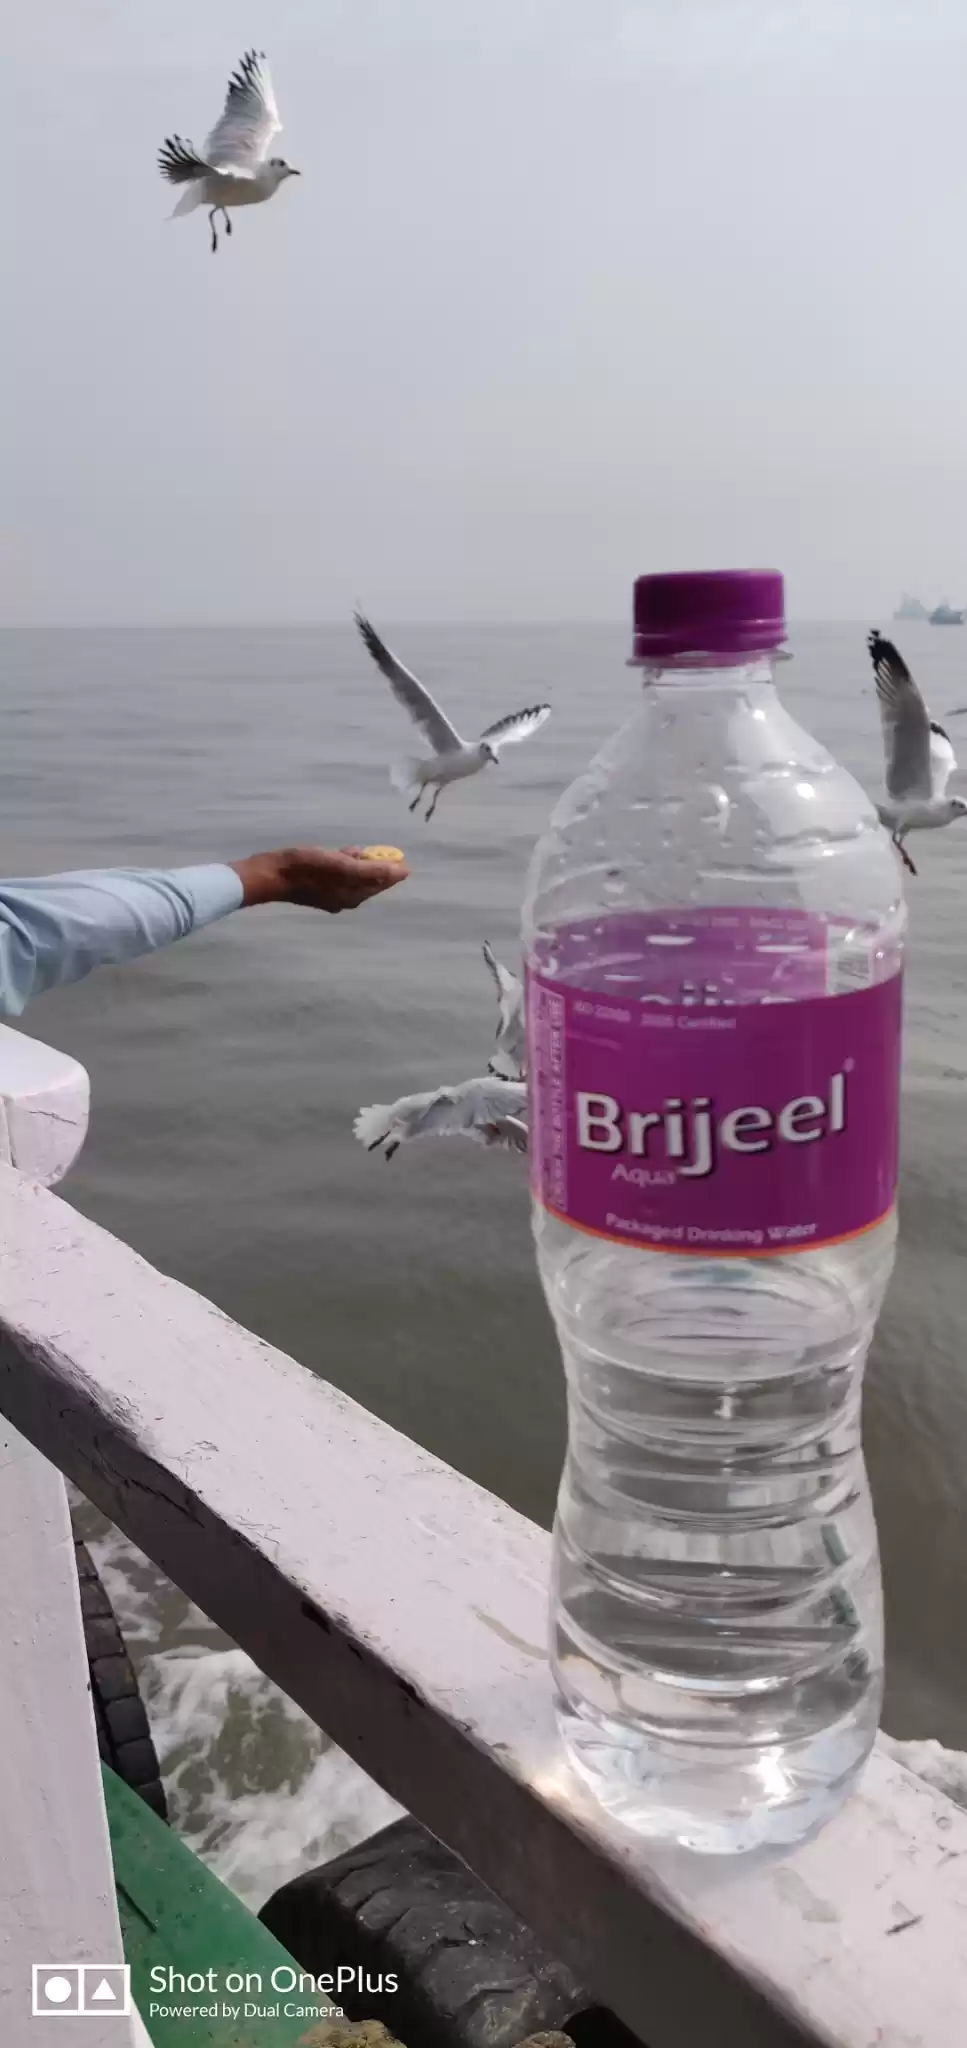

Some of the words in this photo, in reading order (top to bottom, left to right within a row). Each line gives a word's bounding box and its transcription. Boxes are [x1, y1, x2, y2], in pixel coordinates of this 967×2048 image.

[574, 1070, 848, 1177] Brijeel
[611, 1163, 677, 1187] Aqua
[605, 1212, 683, 1241] Packaged
[687, 1226, 764, 1245] Drinking
[767, 1222, 818, 1240] Water
